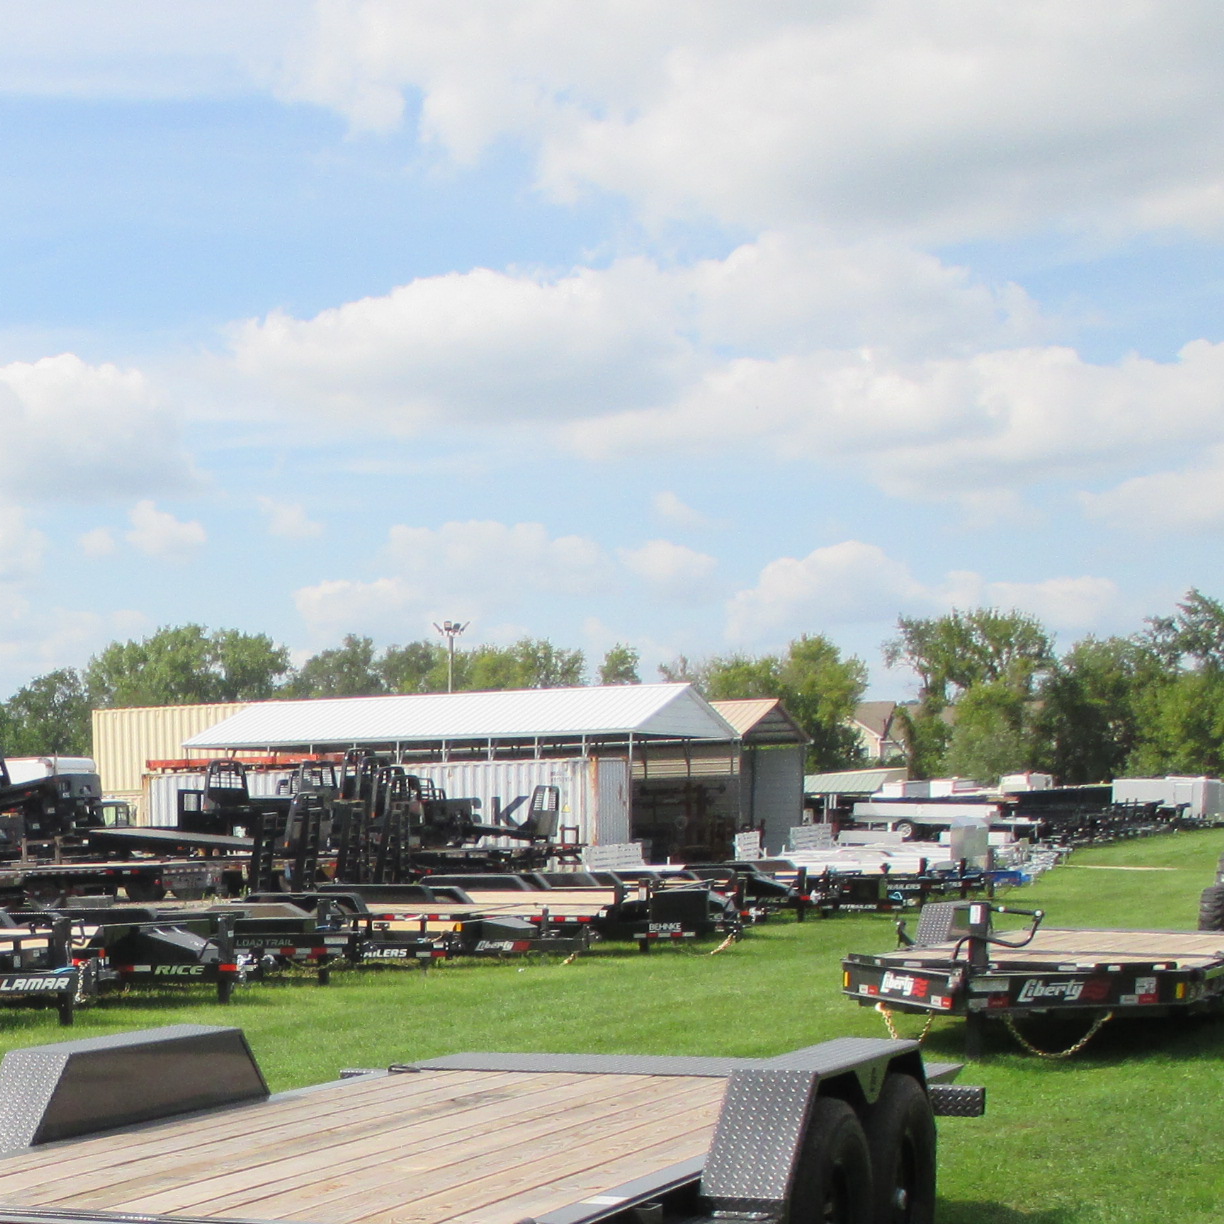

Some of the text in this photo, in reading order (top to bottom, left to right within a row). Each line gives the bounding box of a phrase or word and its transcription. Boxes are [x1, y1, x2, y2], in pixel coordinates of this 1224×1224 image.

[649, 922, 682, 931] BEHNKE
[236, 938, 294, 947] LOAD TRAIL
[154, 964, 206, 976] RICE
[0, 977, 70, 992] LAMAR
[880, 970, 915, 997] Liberty
[1017, 978, 1085, 1003] Liberty
